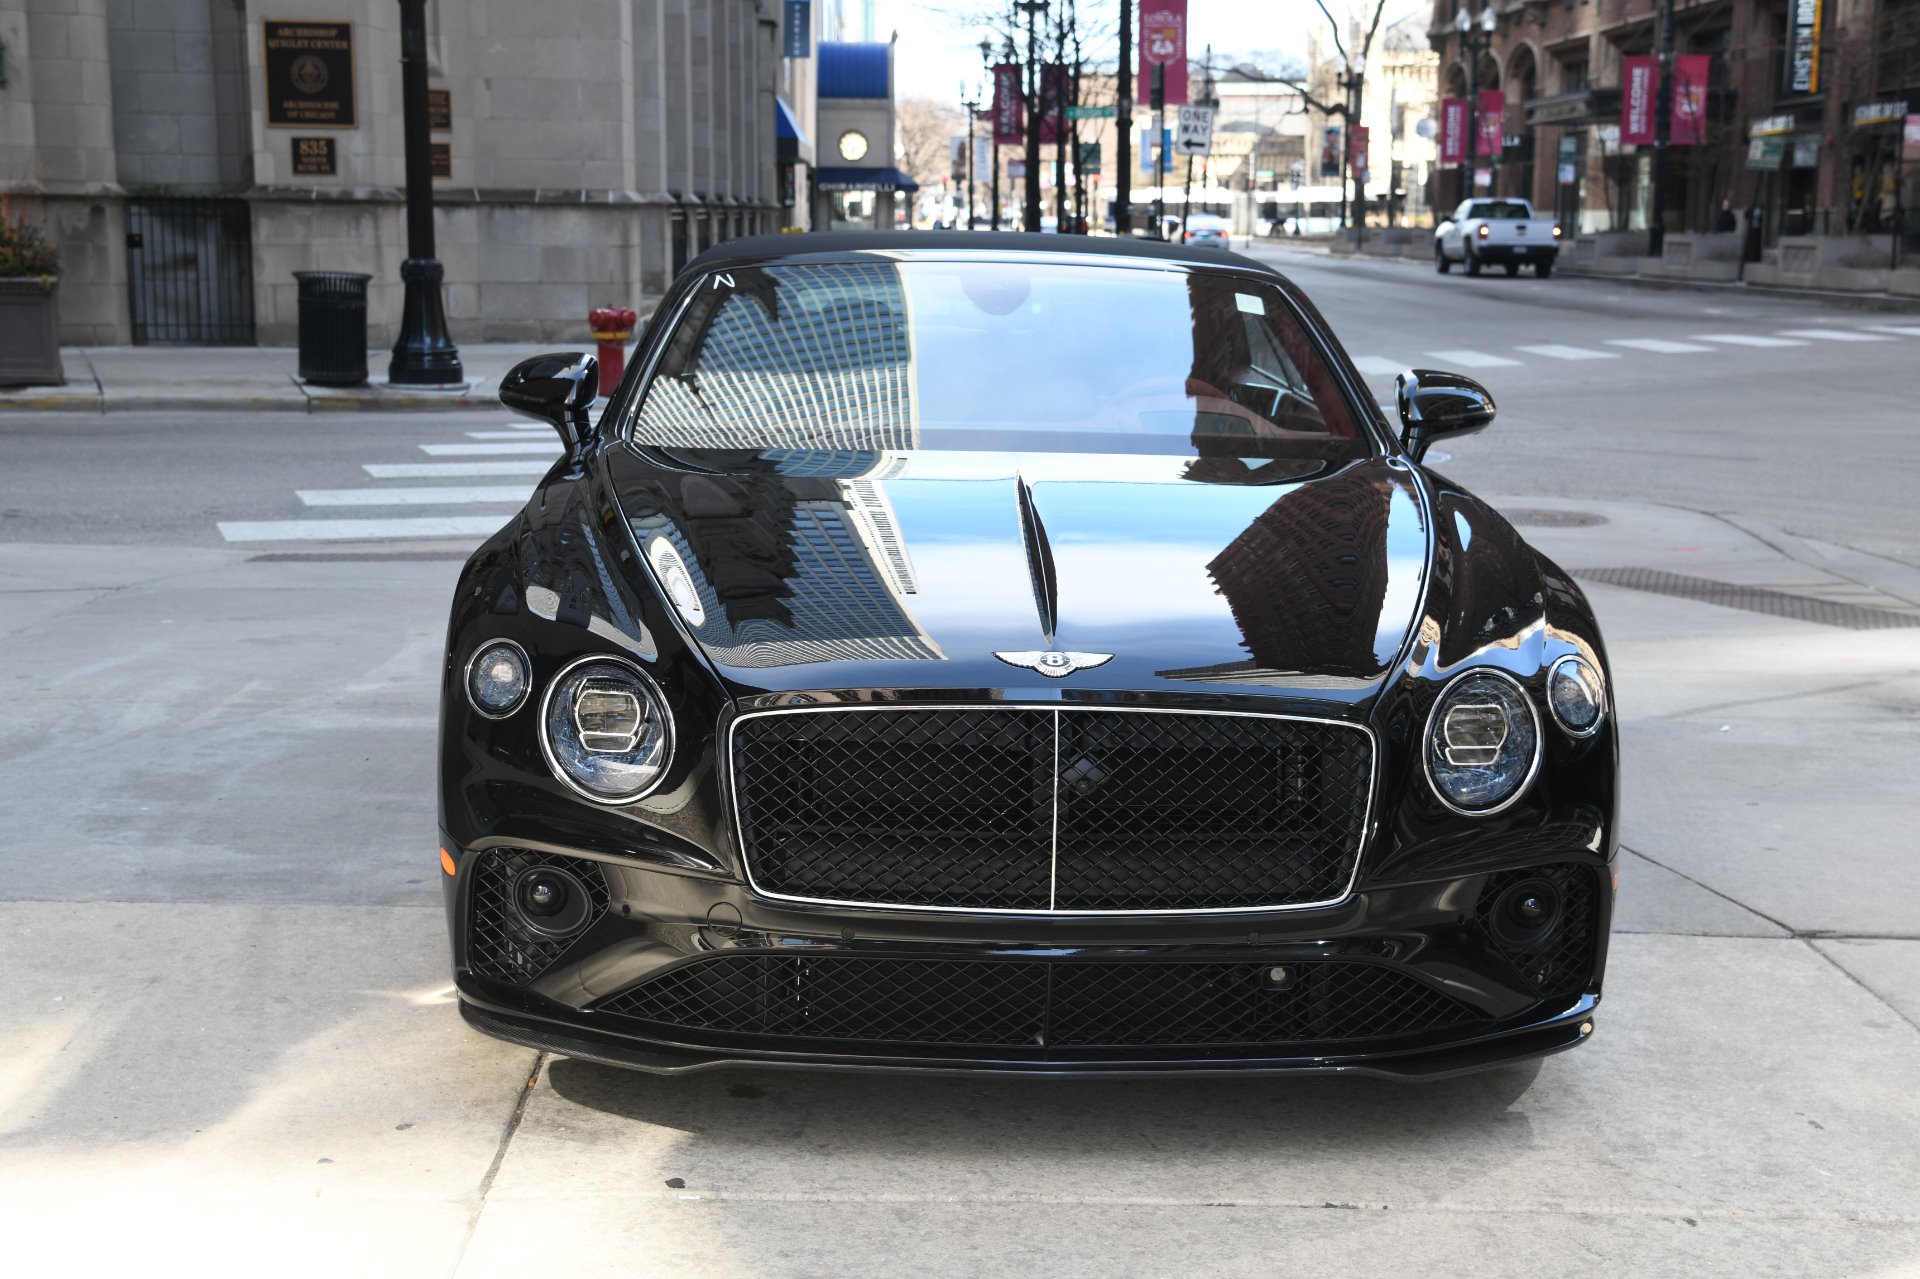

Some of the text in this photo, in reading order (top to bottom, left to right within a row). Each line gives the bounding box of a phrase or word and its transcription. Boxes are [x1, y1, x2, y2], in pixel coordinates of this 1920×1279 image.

[311, 40, 348, 49] CENTER
[1628, 67, 1642, 134] WELCOME
[1182, 110, 1209, 123] ONE
[1181, 124, 1209, 136] WAY
[299, 140, 328, 156] 835
[818, 182, 896, 192] GHIRARDELLI
